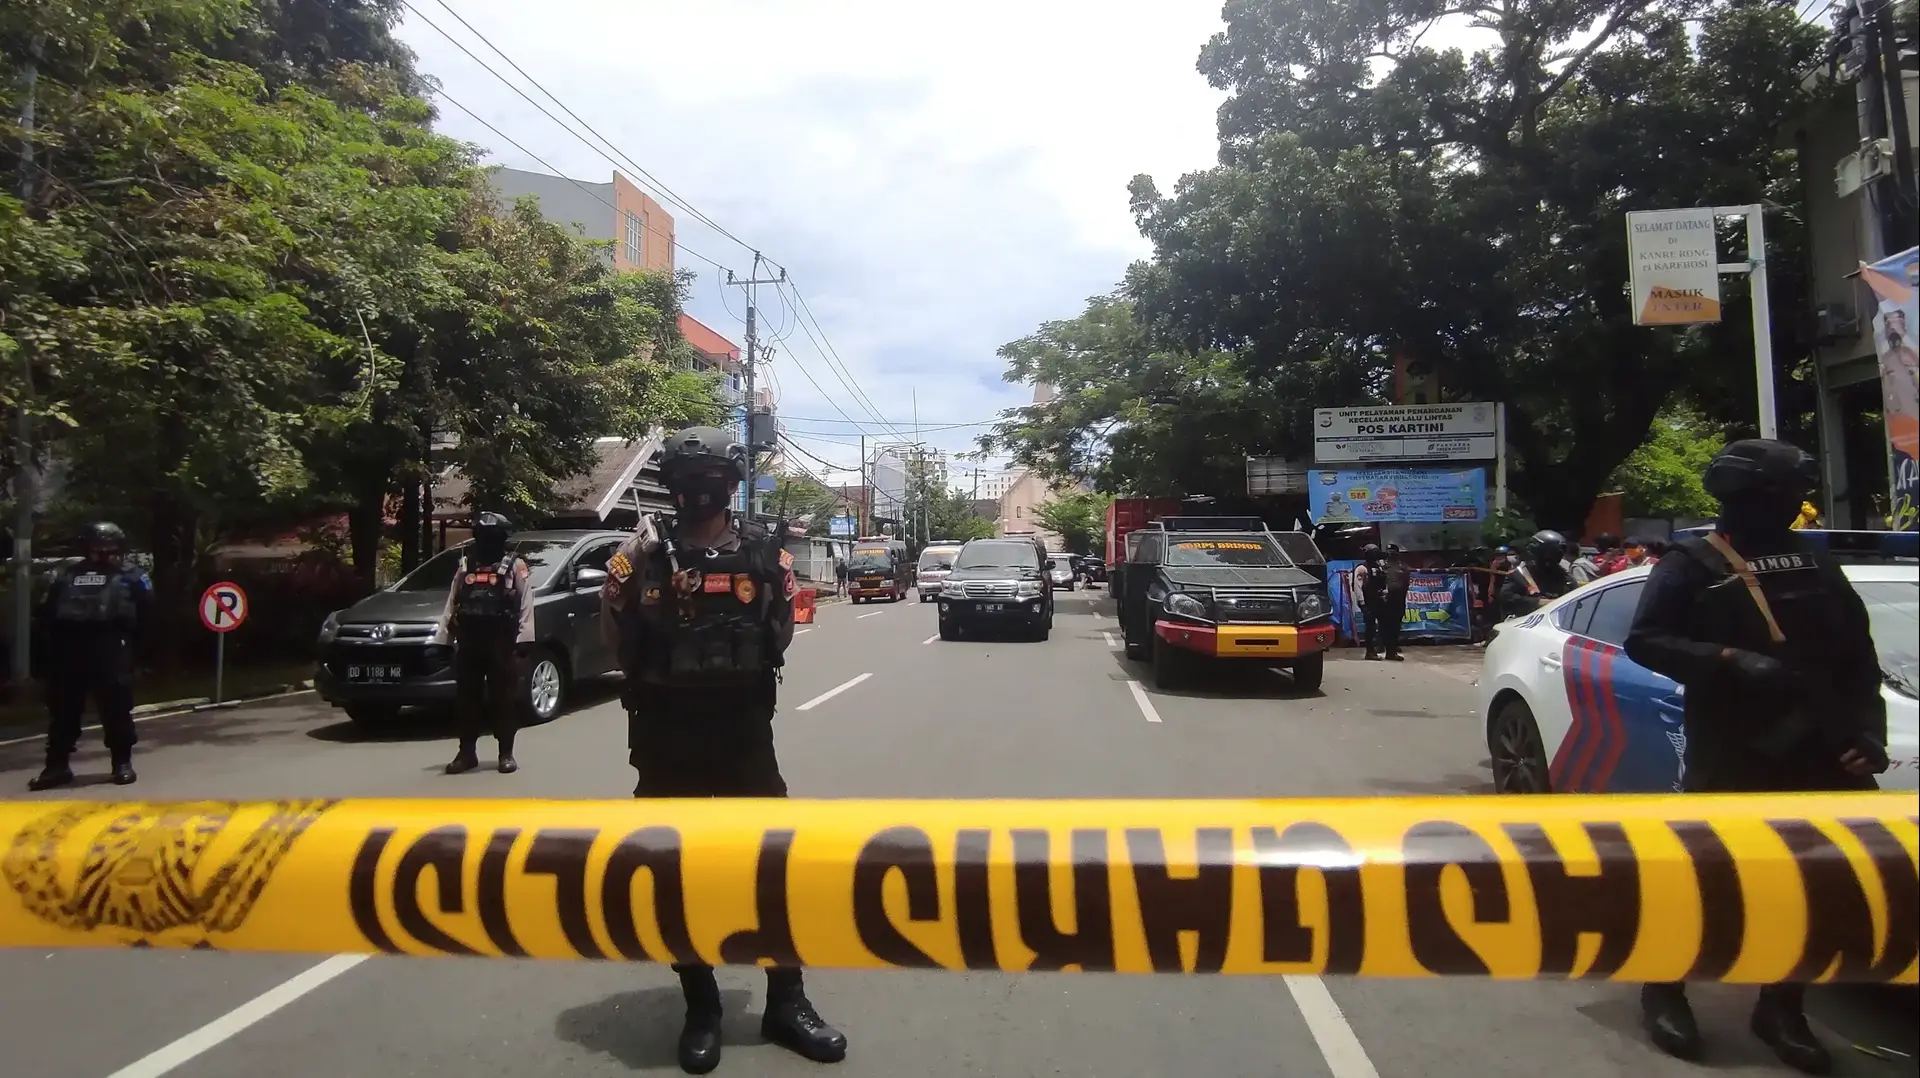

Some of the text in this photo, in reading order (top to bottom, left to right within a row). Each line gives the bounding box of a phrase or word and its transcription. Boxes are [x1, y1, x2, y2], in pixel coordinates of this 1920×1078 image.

[1634, 219, 1710, 233] SELAMAT DATANG
[1640, 249, 1710, 260] KANRE RONG
[1654, 260, 1708, 271] KAREBOSI
[1650, 288, 1704, 299] MASUK
[1653, 302, 1702, 312] ENTER
[1359, 409, 1405, 417] PELAYANAN
[1348, 416, 1400, 424] KECELAKAAN
[1357, 422, 1444, 434] POS KARTINI
[1350, 492, 1366, 500] 5M
[1217, 542, 1263, 550] BRIMOB
[1746, 555, 1804, 572] RIMOB
[1432, 591, 1453, 602] SIM
[349, 824, 807, 968] POLISI
[852, 820, 1366, 976] GARIS
